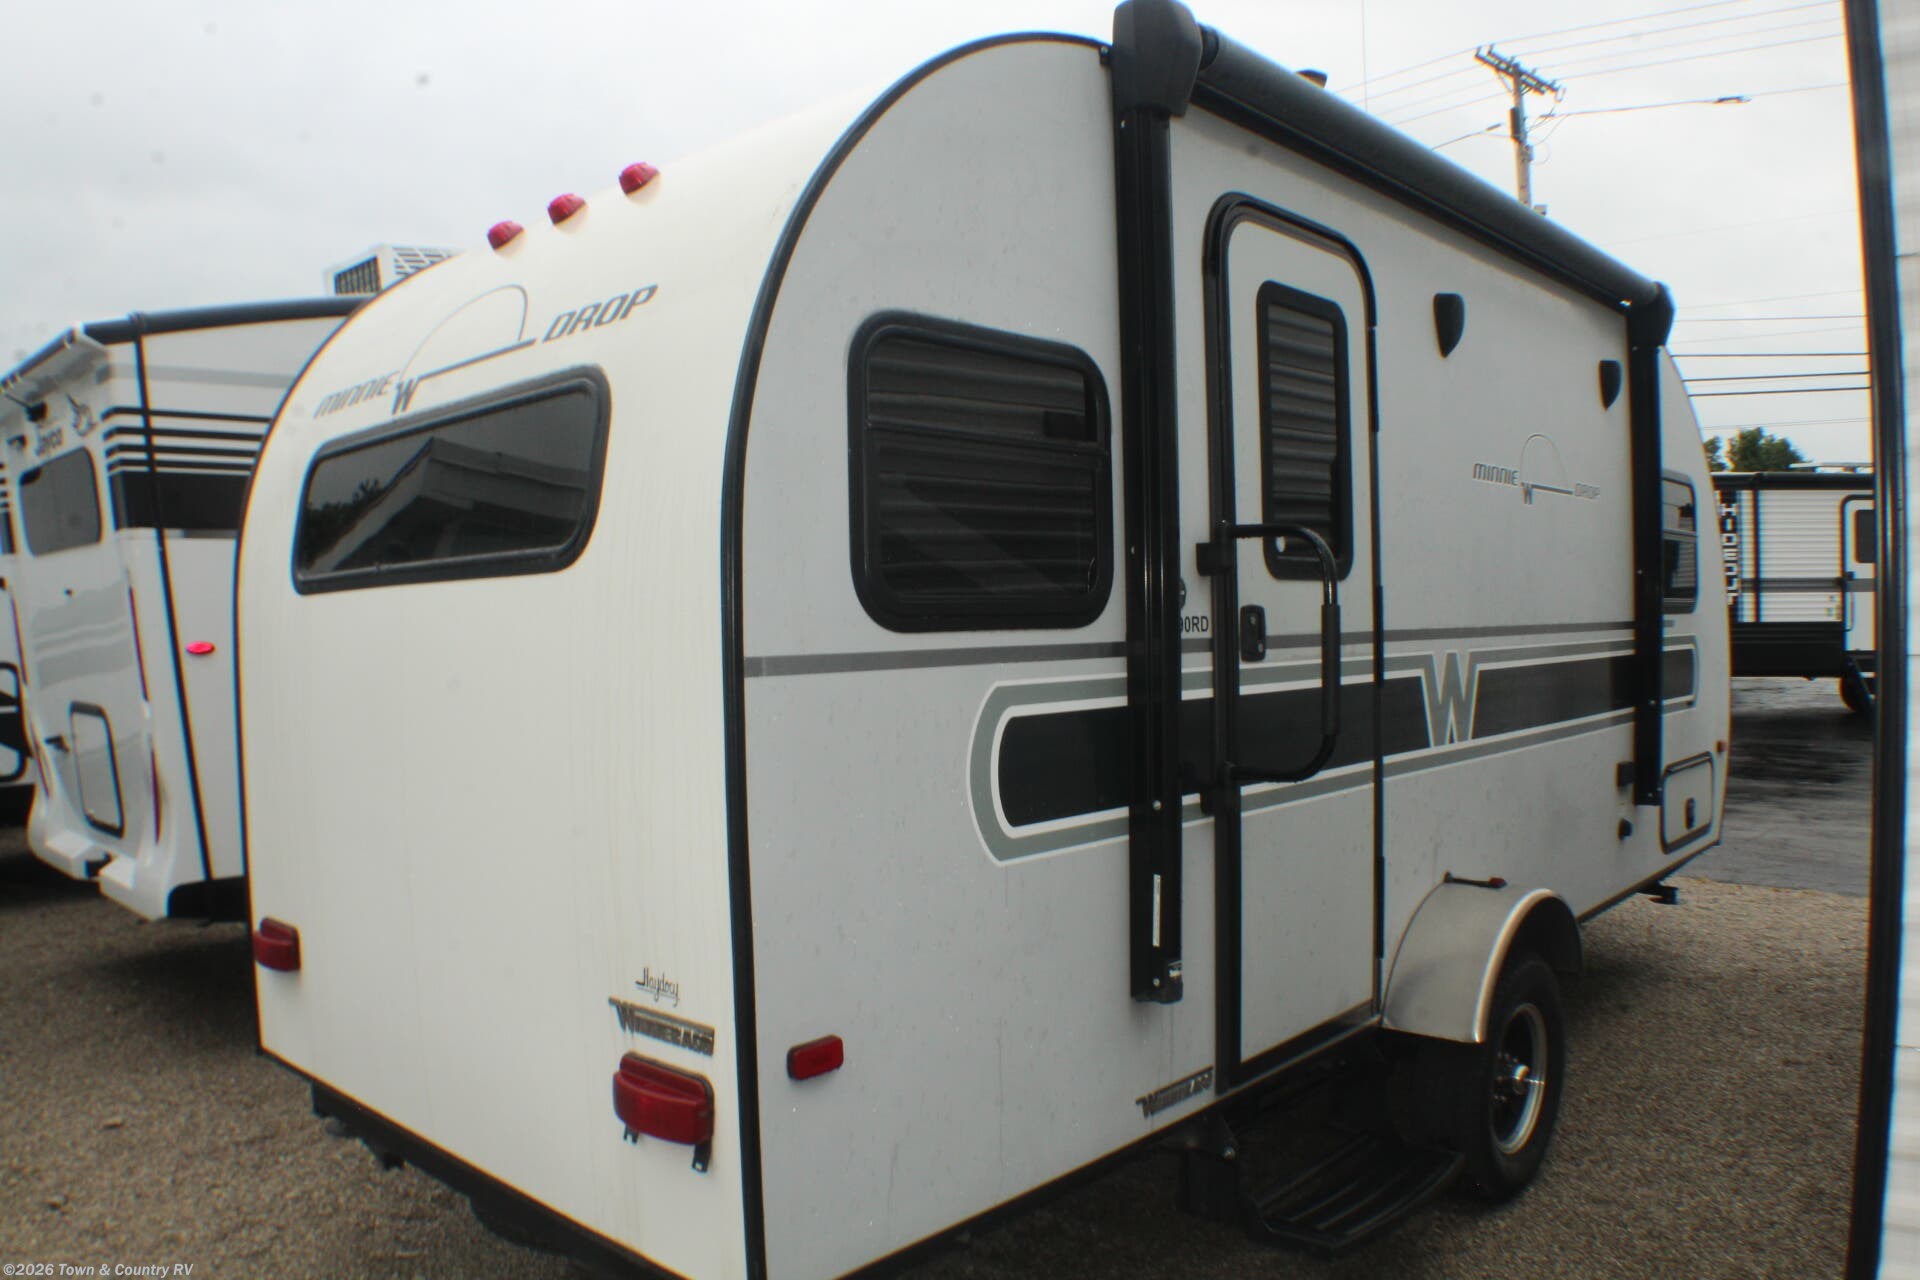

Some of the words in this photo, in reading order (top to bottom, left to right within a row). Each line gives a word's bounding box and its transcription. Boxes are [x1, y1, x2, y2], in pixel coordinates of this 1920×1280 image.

[313, 370, 400, 419] MINNIE
[541, 283, 658, 344] DROP
[1472, 462, 1519, 487] MINNIE
